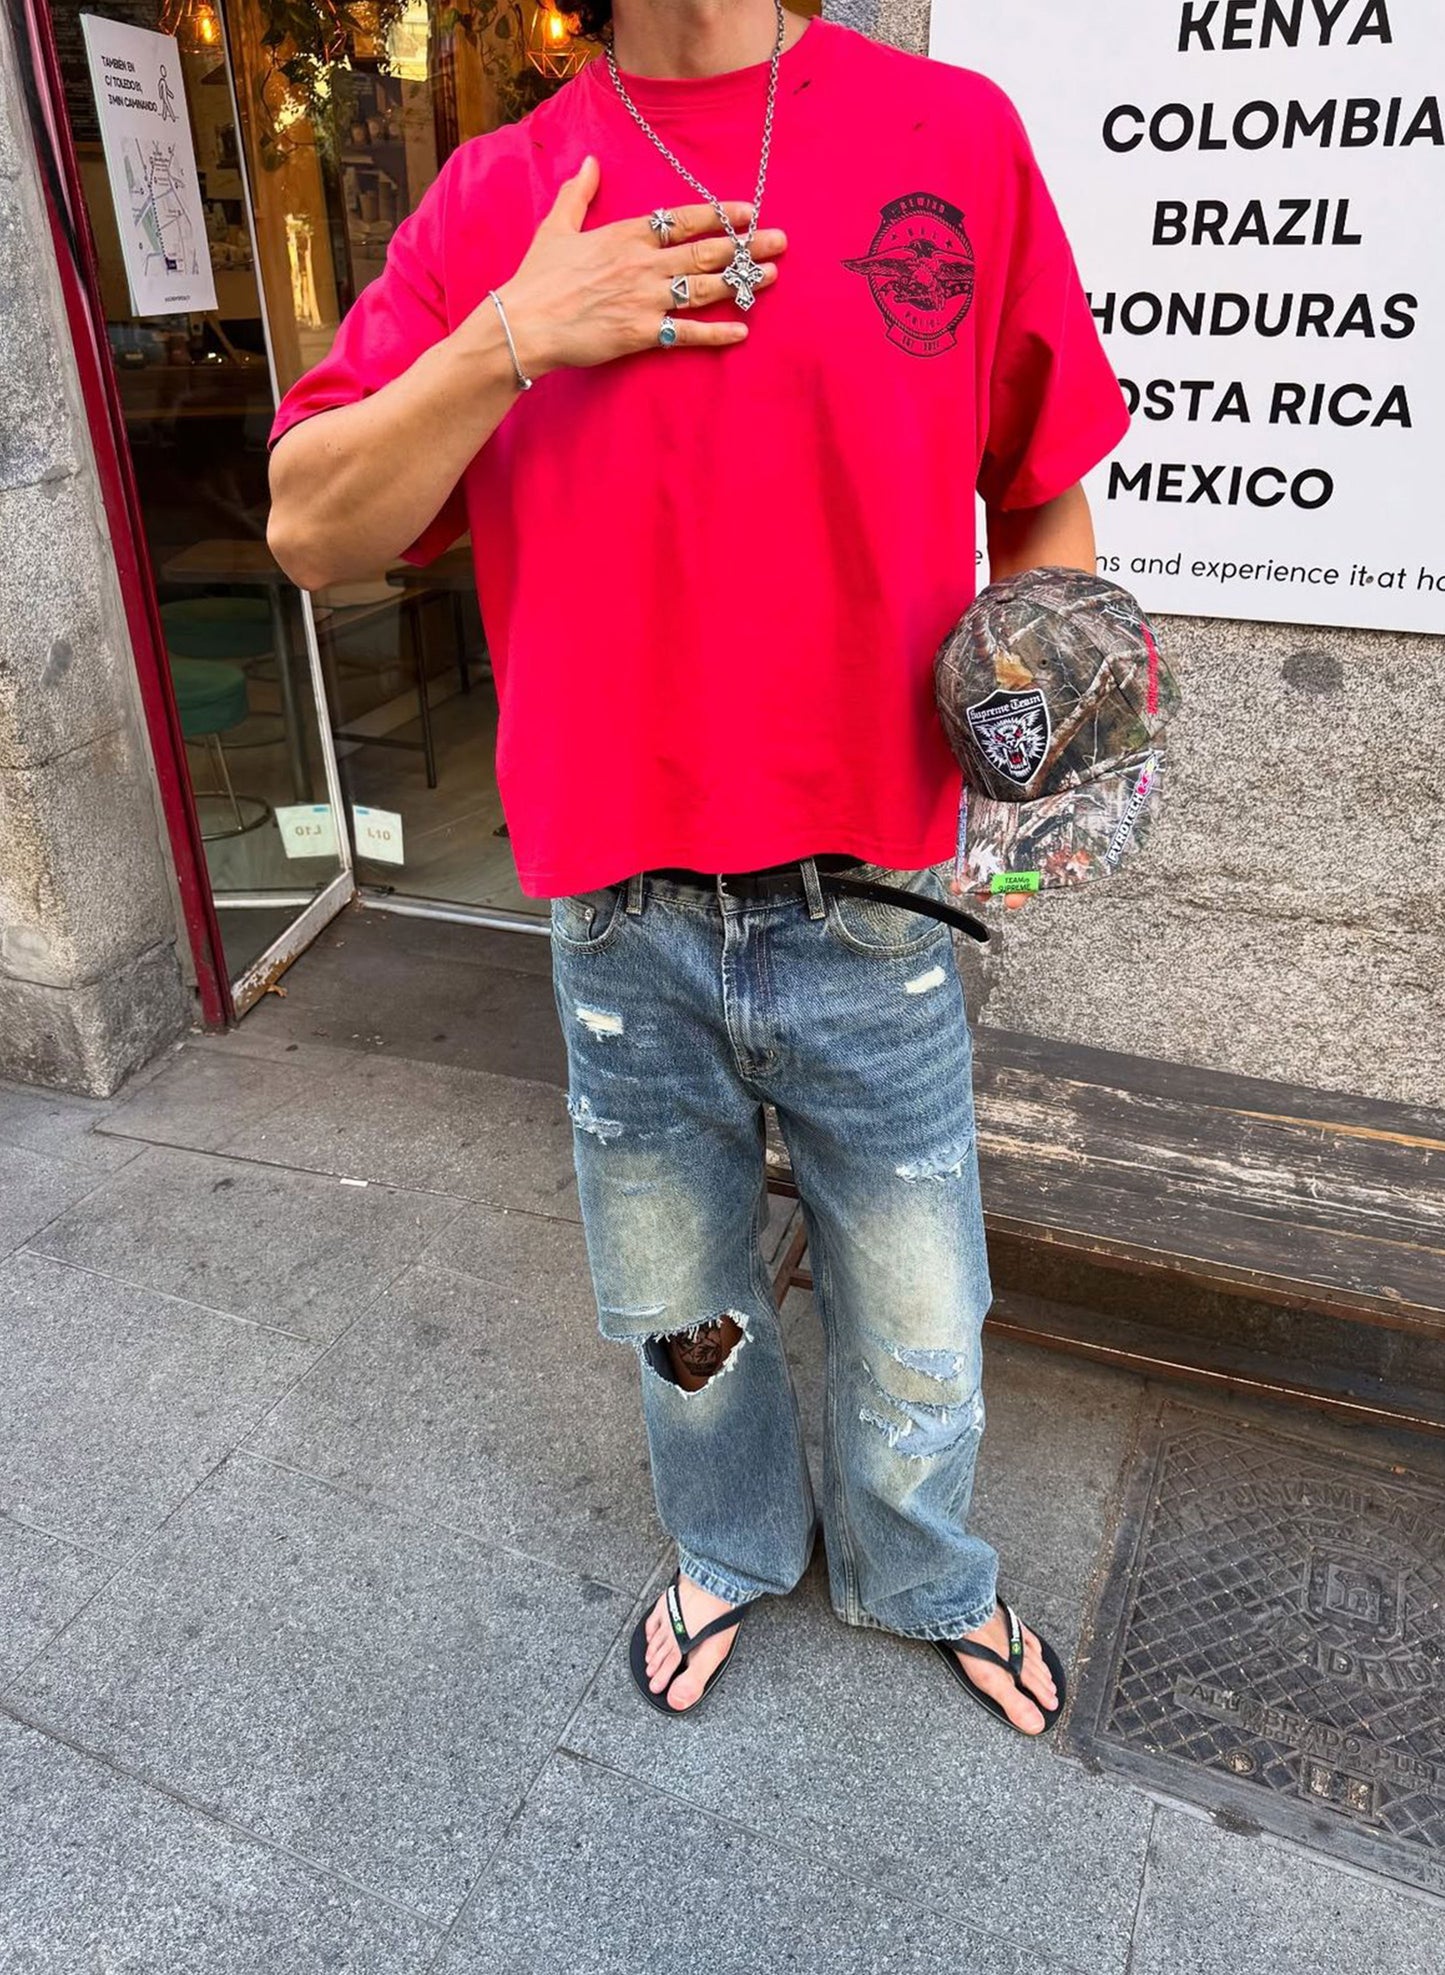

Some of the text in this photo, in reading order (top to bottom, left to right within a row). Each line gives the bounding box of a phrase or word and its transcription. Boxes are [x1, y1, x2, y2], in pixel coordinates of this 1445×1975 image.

[1178, 0, 1392, 51] KENYA
[1103, 97, 1445, 152] COLOMBIA
[1153, 199, 1361, 245] BRAZIL
[1086, 291, 1417, 338] HONDURAS
[1268, 383, 1411, 427] RICA
[1108, 462, 1333, 509] MEXICO
[1131, 552, 1181, 575] and
[1191, 559, 1339, 585] experience
[1350, 564, 1367, 587] it
[1378, 568, 1406, 589] at
[970, 694, 1041, 720] Supreme Team
[1108, 792, 1144, 860] PYROTECH
[1189, 1682, 1361, 1755] ALUMBRADO
